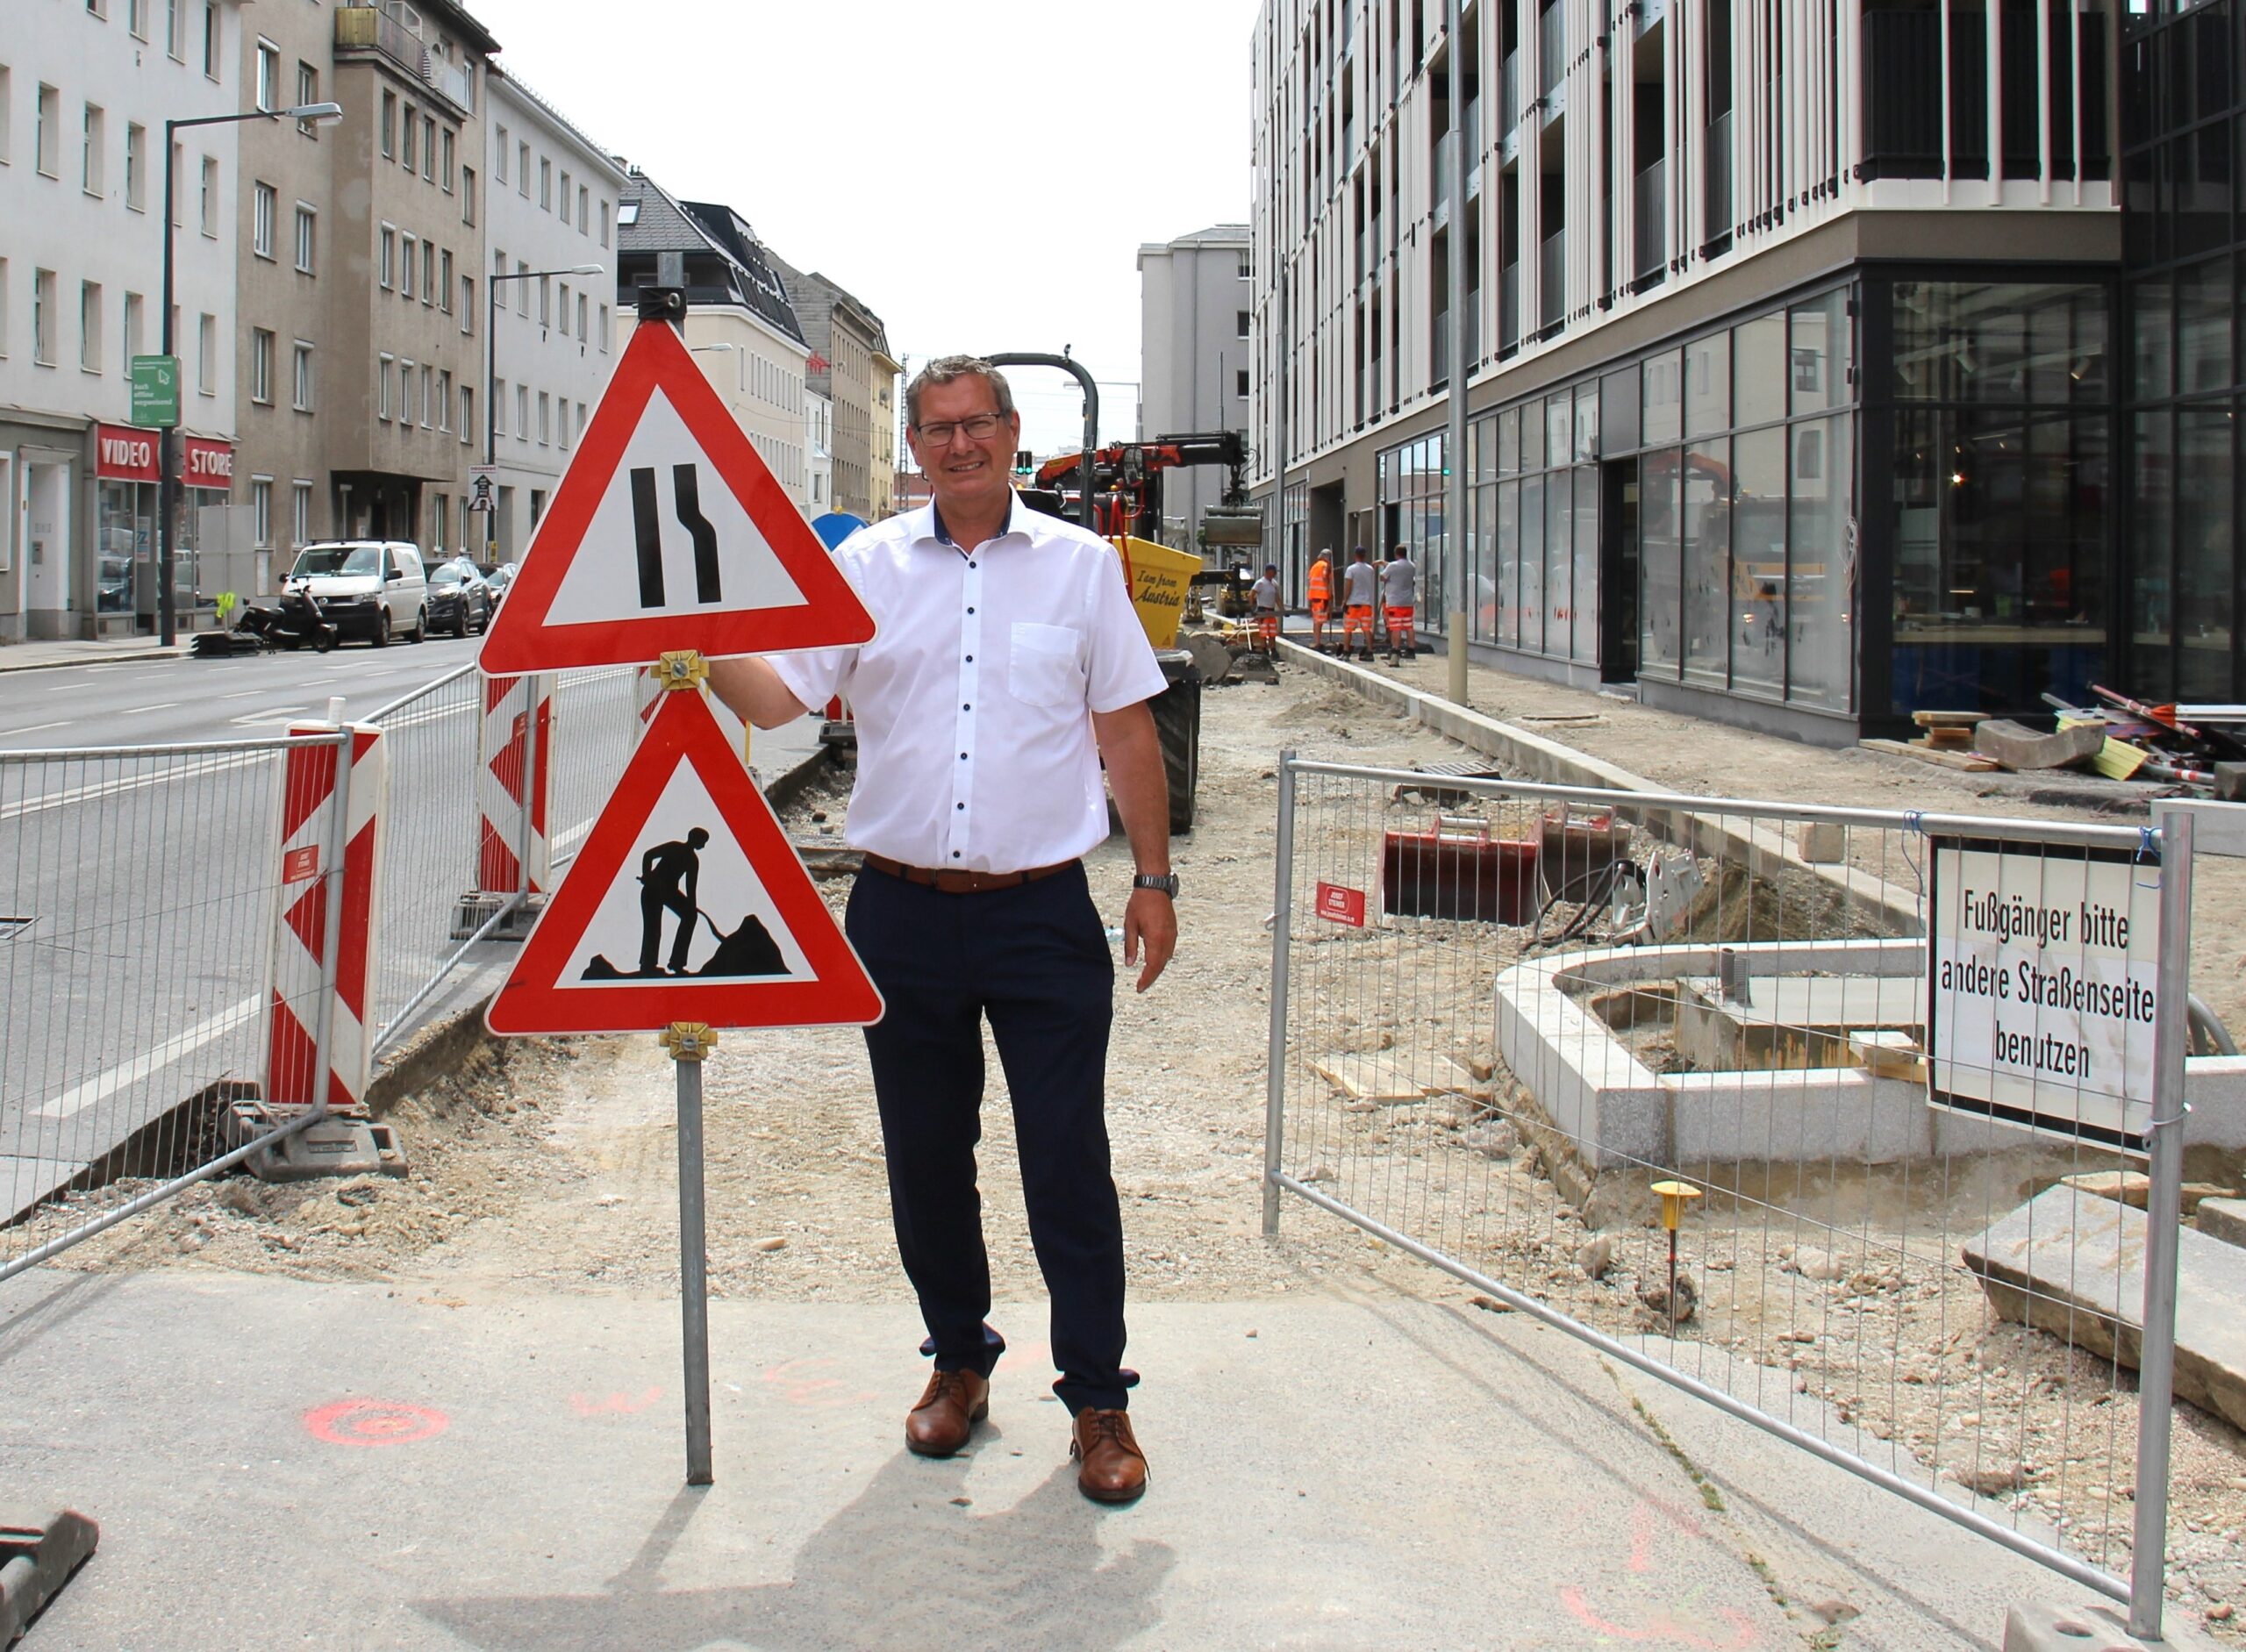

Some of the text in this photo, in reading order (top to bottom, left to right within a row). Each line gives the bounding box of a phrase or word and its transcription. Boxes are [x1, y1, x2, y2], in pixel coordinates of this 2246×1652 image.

[101, 438, 232, 476] VIDEO STORE
[1134, 586, 1180, 606] Austria
[1136, 569, 1177, 588] I am from
[1964, 890, 2128, 949] Fußgänger bitte
[1942, 955, 2154, 1023] andere Straßenseite
[1995, 1020, 2090, 1078] benutzen
